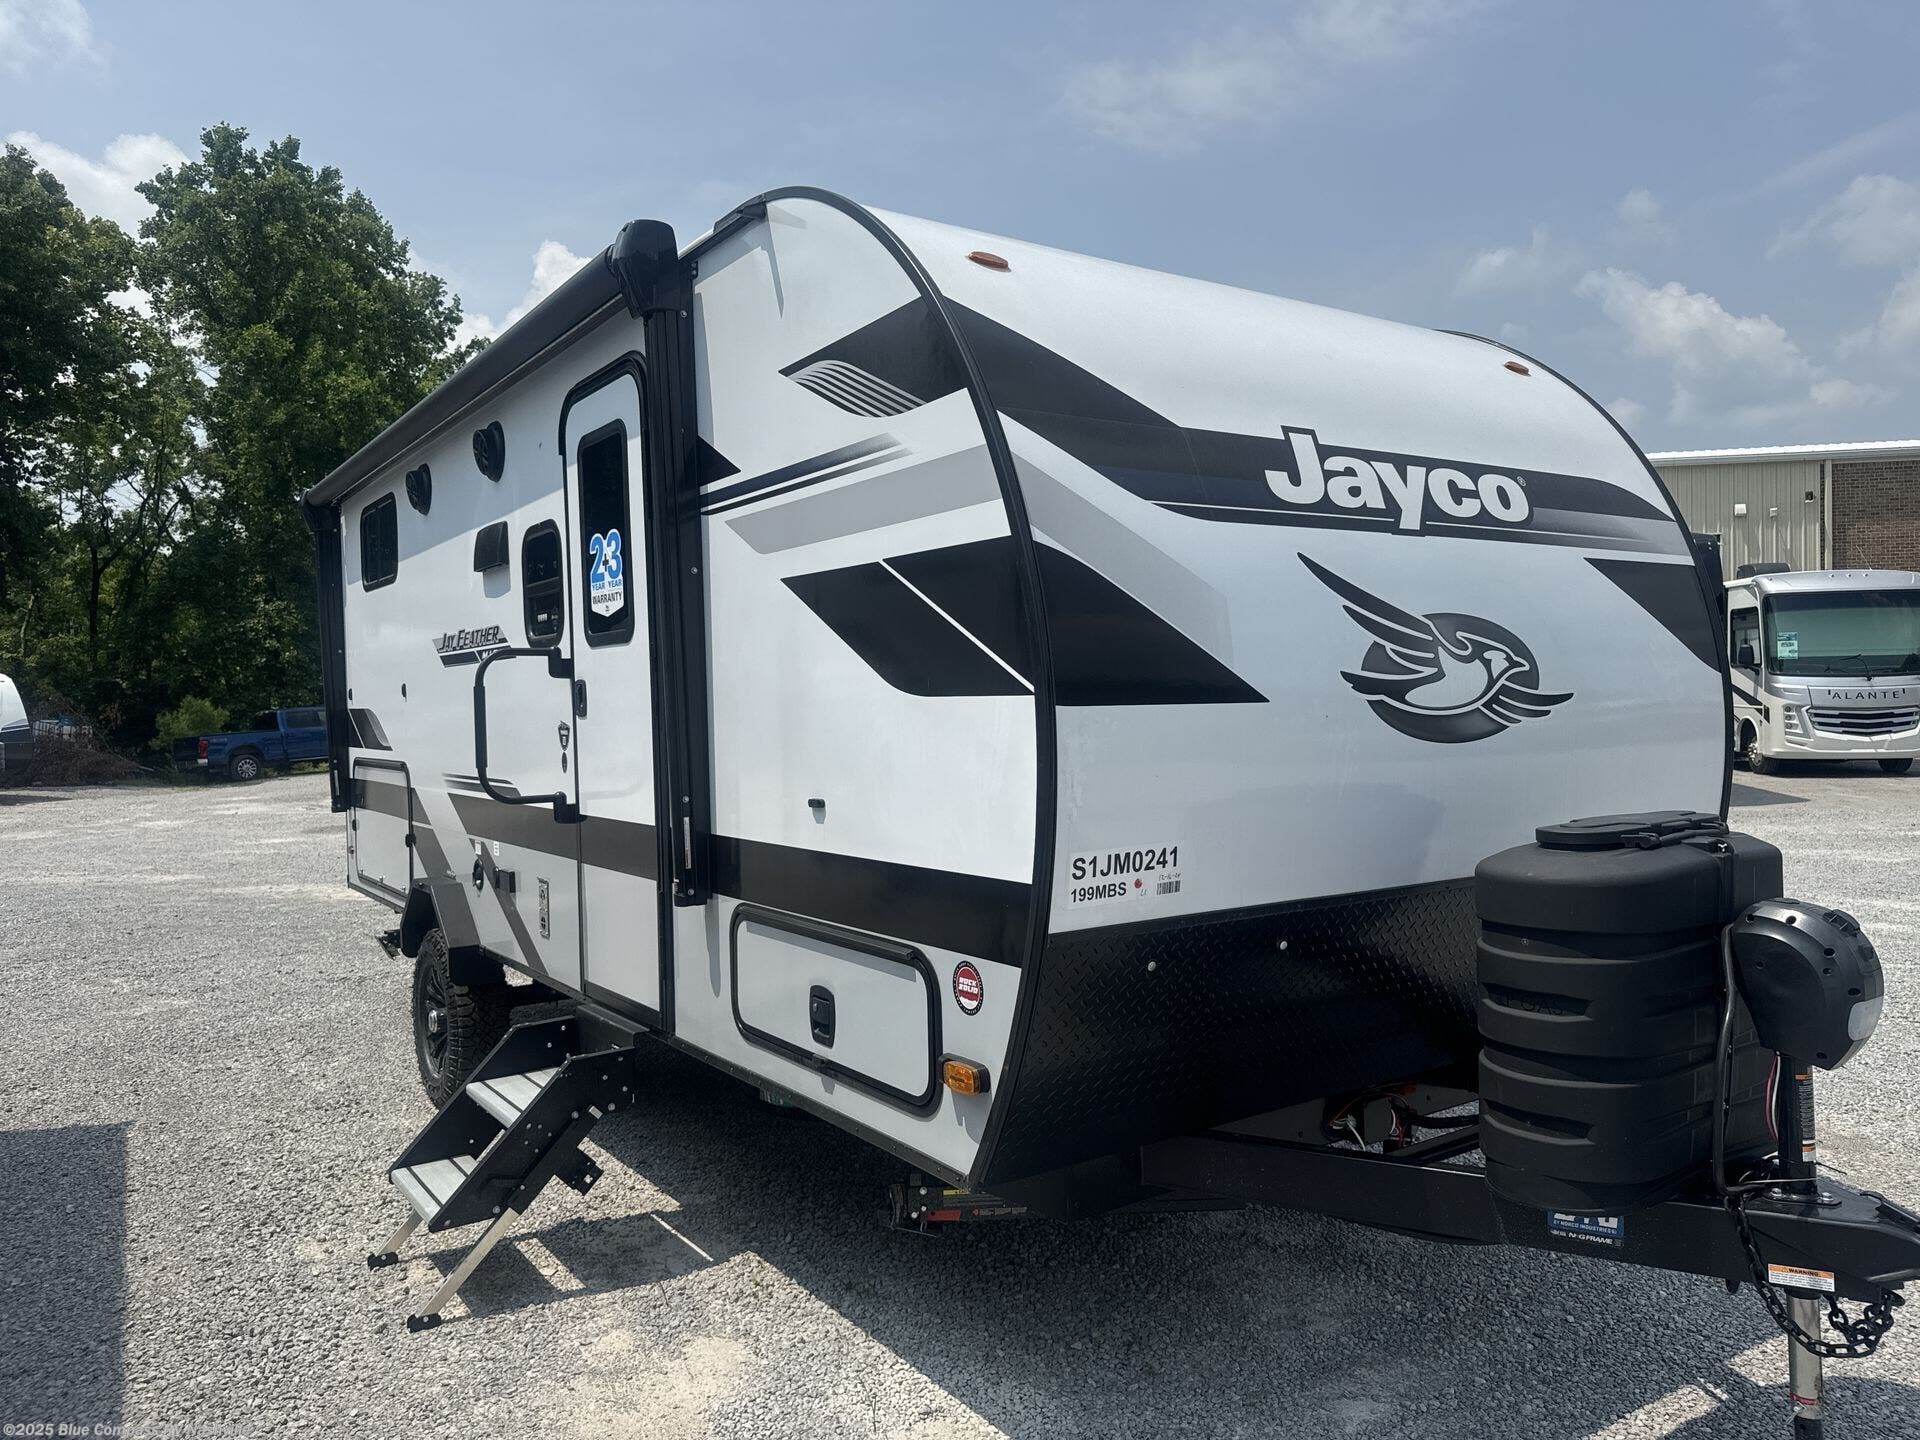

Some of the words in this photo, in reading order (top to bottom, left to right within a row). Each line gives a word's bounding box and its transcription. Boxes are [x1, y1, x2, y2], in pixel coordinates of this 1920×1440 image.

[1264, 432, 1529, 530] Jayco
[592, 583, 605, 591] YEAR
[608, 579, 622, 588] YEAR
[592, 591, 622, 604] WARRANTY
[1071, 846, 1178, 880] S1JM0241
[1071, 882, 1127, 903] 199MBS
[959, 977, 977, 987] ROCK
[958, 983, 979, 994] SOLID
[1788, 1267, 1819, 1277] WARNING
